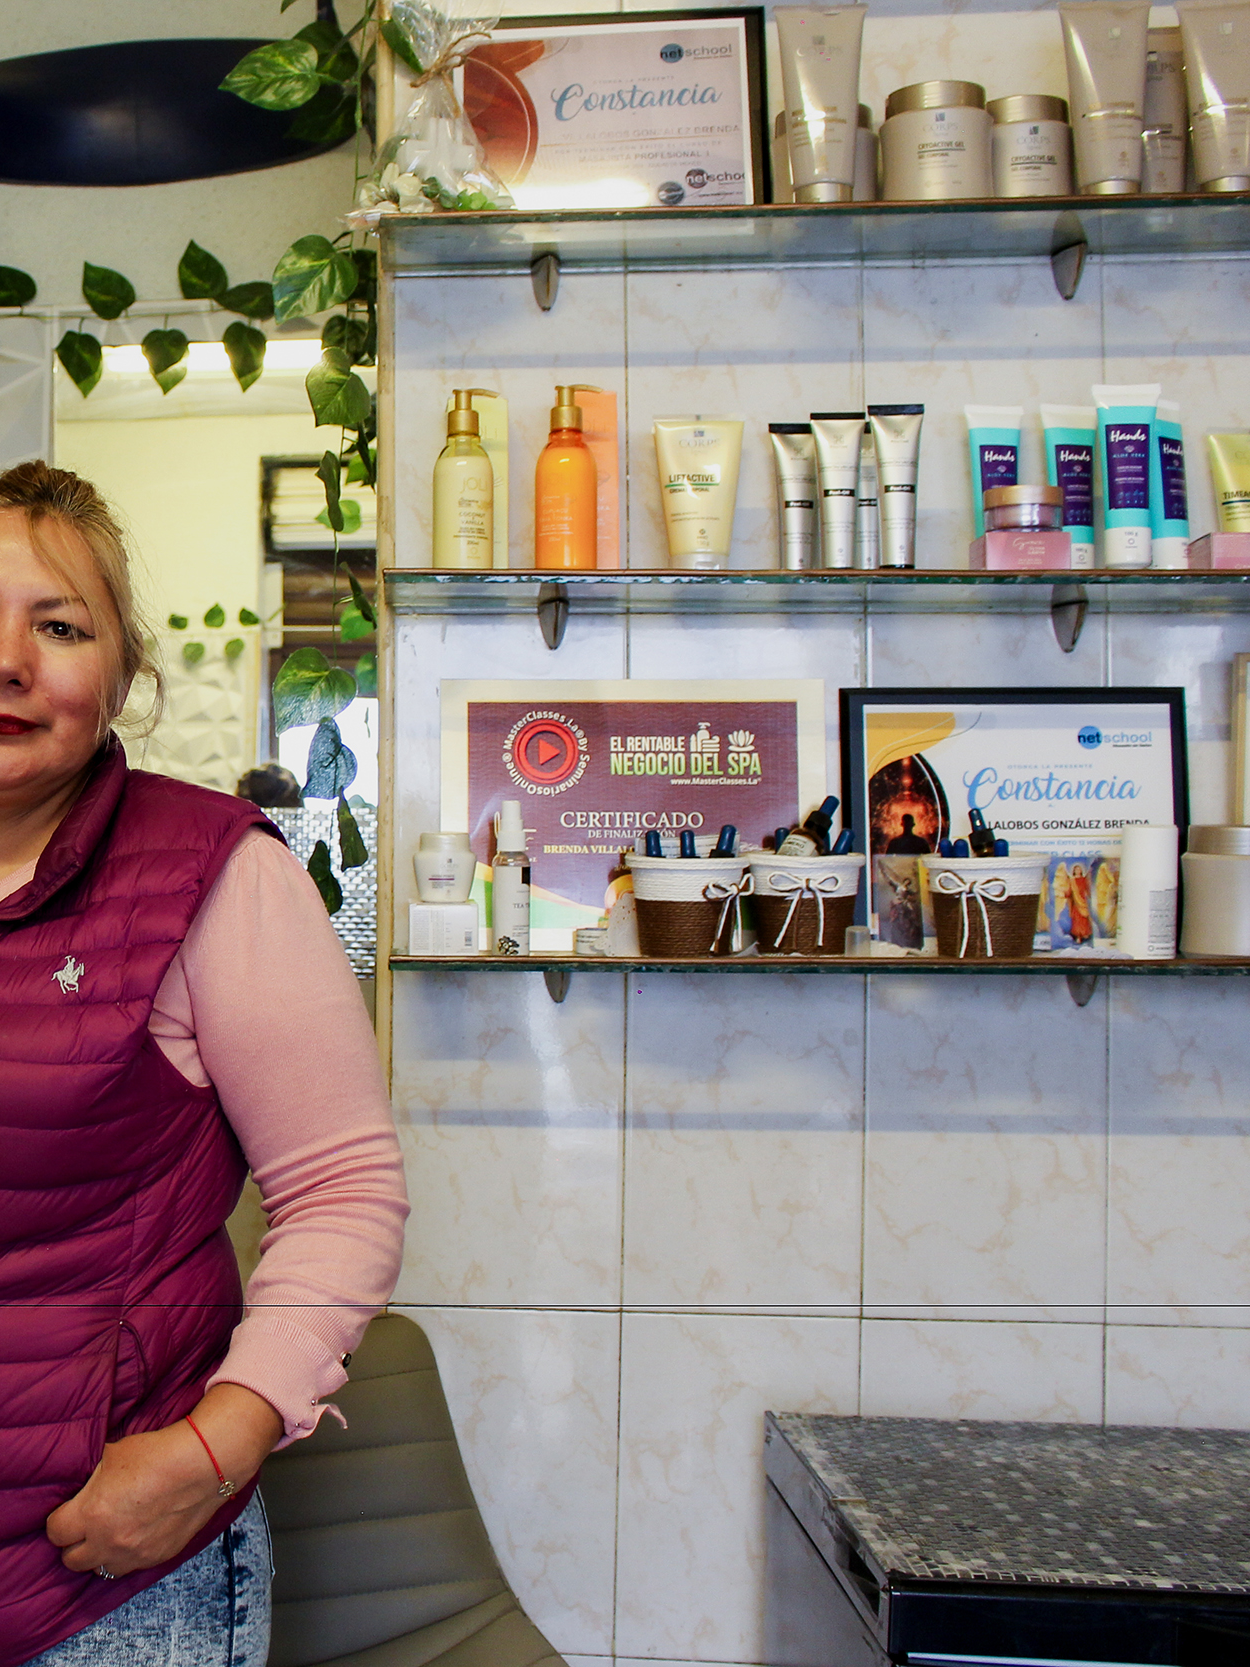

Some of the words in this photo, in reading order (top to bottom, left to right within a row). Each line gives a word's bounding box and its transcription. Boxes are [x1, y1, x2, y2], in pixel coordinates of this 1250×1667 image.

[660, 44, 732, 59] netschool
[551, 83, 723, 121] Constancia
[634, 150, 702, 160] PROFESIONAL
[1110, 429, 1147, 443] Hands
[984, 450, 1015, 462] Hands
[1060, 450, 1090, 462] Hands
[669, 474, 715, 483] LIFTACTIVE
[1223, 491, 1250, 499] TIMEA
[610, 736, 625, 752] EL
[627, 736, 685, 752] RENTABLE
[1077, 731, 1152, 744] netschool
[610, 752, 686, 776] NEGOCIO
[690, 752, 724, 776] DEL
[727, 752, 762, 776] SPA
[963, 767, 1142, 810] Constancia
[560, 811, 705, 829] CERTIFICADO
[988, 820, 1039, 830] LALOBOS
[1042, 817, 1102, 829] GONZÁLEZ
[588, 829, 602, 838] DE
[543, 845, 589, 854] BRENDA
